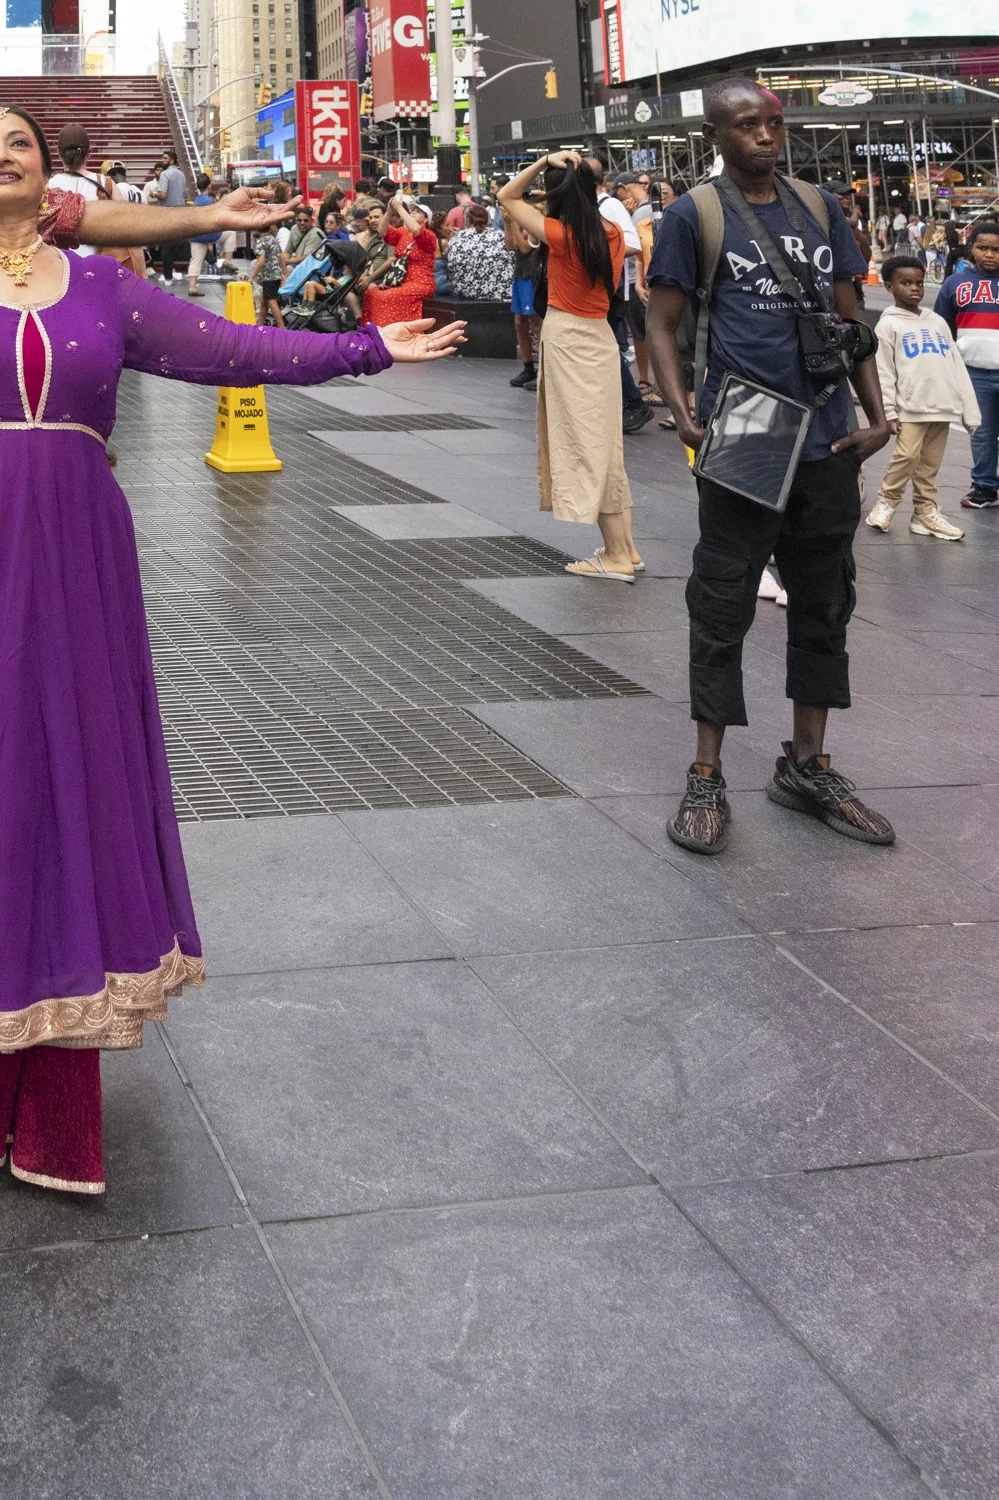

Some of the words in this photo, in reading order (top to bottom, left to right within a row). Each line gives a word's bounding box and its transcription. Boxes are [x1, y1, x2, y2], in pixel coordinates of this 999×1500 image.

[312, 86, 350, 163] tkts
[855, 143, 909, 156] CENTRAL
[914, 141, 953, 155] PERK
[956, 280, 999, 308] GA
[751, 301, 799, 310] ORIGINAL
[902, 328, 950, 359] GAP
[240, 398, 256, 406] PISO
[234, 409, 263, 418] MOJADO
